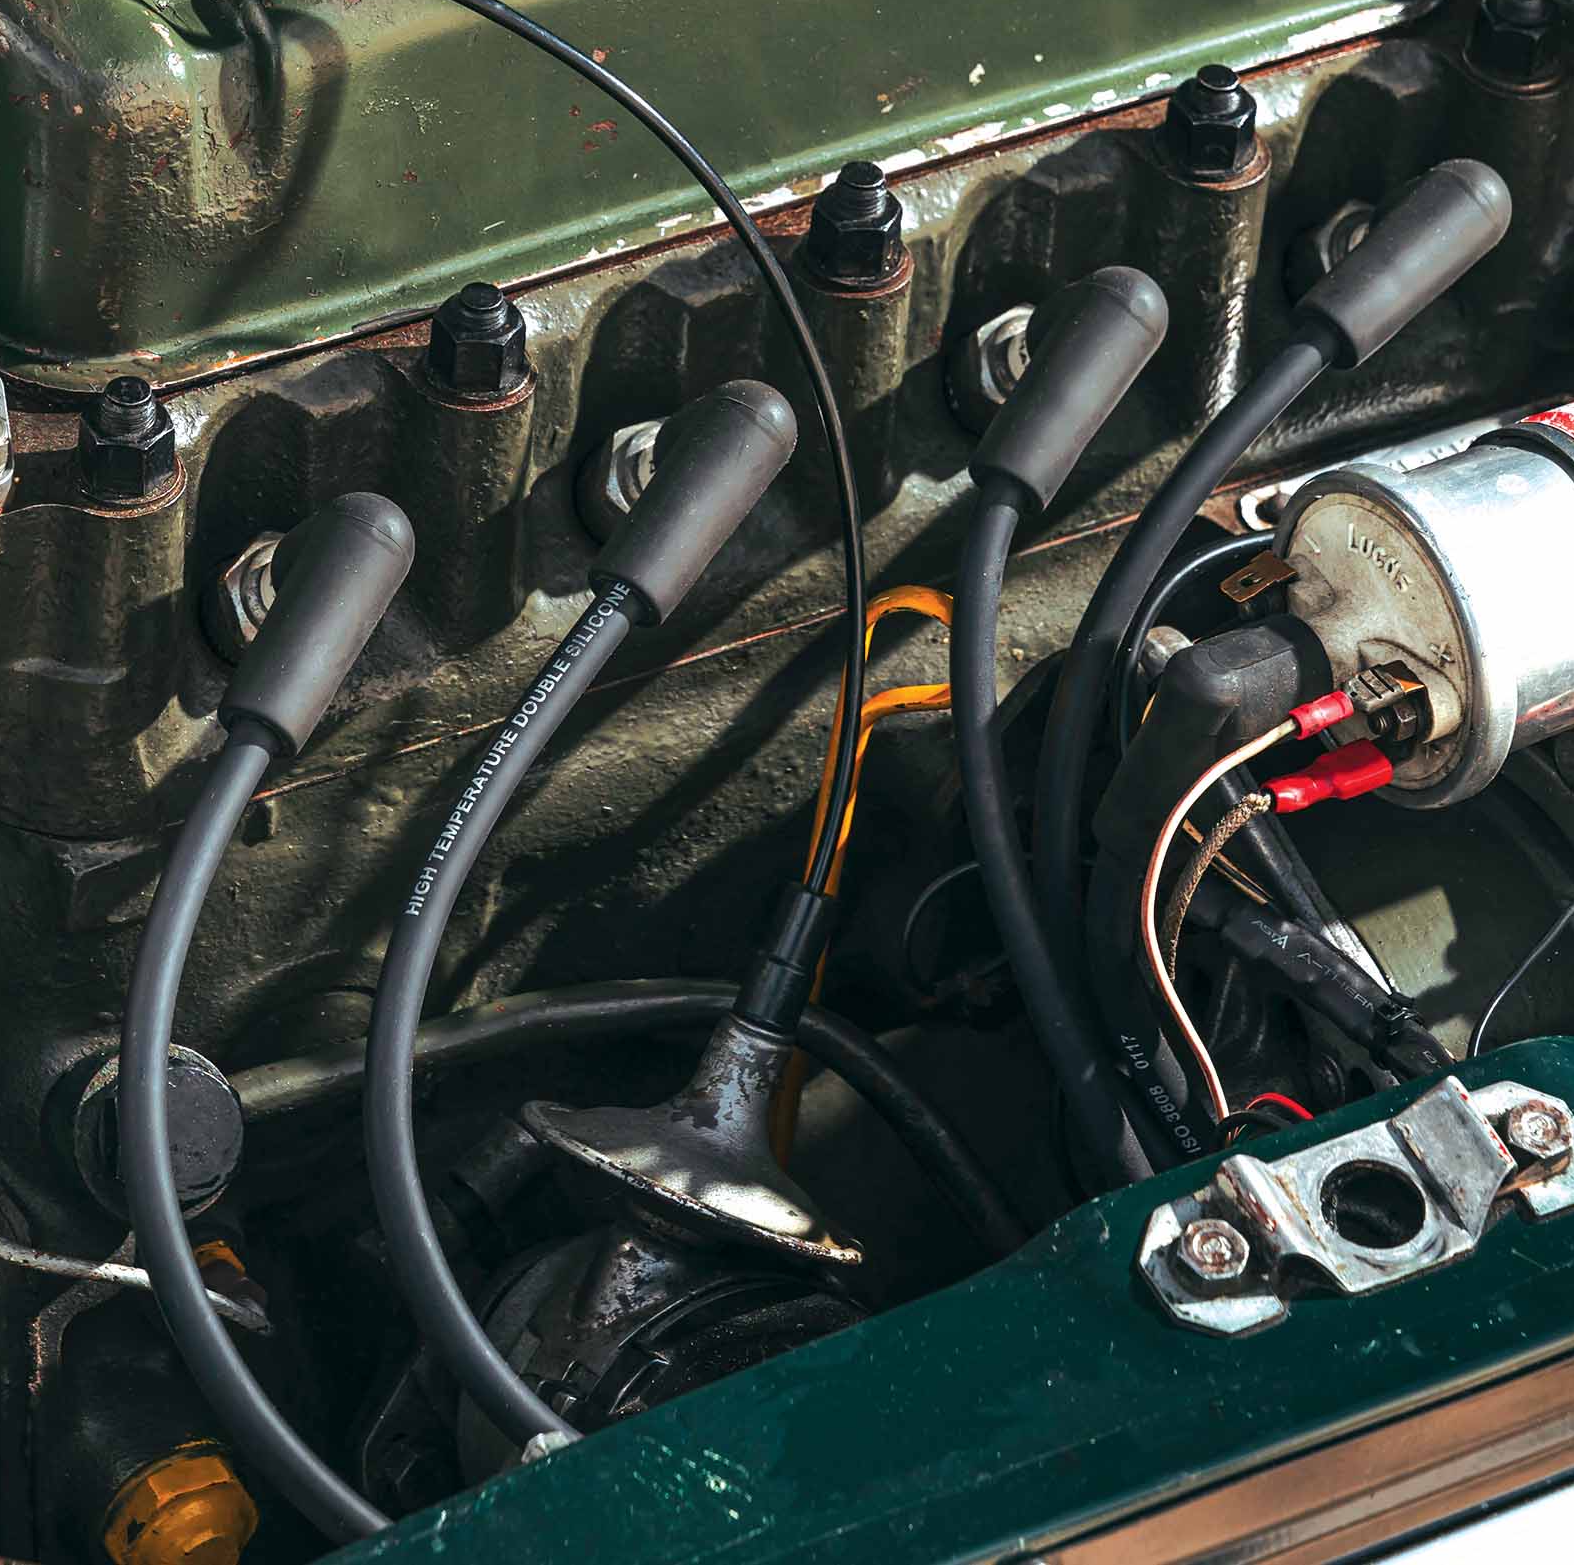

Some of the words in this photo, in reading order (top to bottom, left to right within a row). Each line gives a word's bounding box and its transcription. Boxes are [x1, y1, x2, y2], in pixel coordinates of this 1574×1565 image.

[405, 866, 438, 916] HIGH
[428, 728, 519, 861] TEMPERATURE
[511, 657, 572, 728] DOUBLE
[564, 581, 631, 657] SILICONE
[1148, 1084, 1182, 1124] 3808
[1173, 1124, 1202, 1154] ISO
